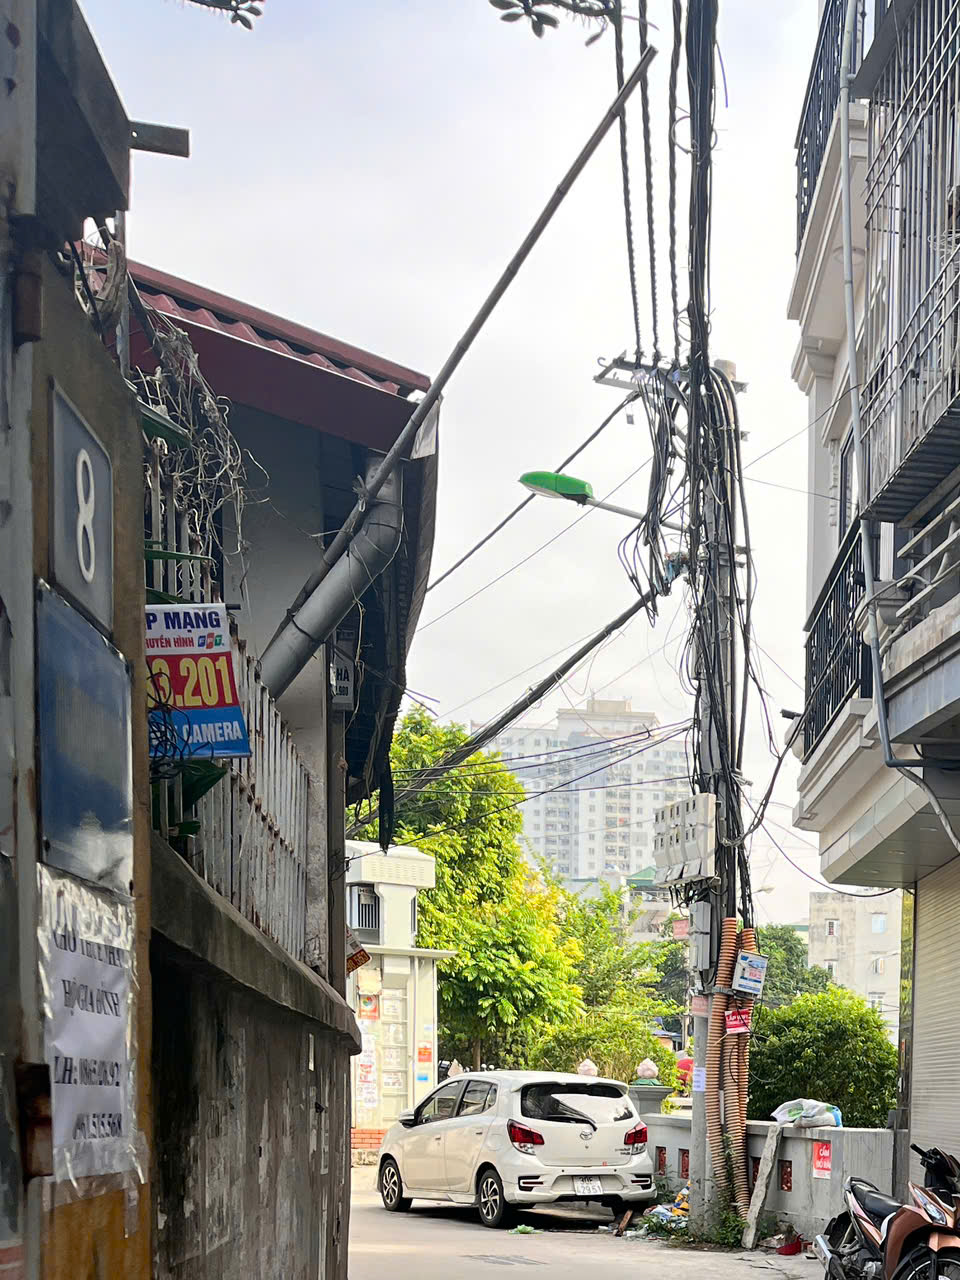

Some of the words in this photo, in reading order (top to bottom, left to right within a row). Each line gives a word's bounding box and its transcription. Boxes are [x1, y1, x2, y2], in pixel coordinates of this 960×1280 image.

[76, 448, 95, 583] 8
[164, 611, 221, 633] MẠNG
[173, 634, 194, 648] HÌNH
[182, 720, 243, 744] CAMERA
